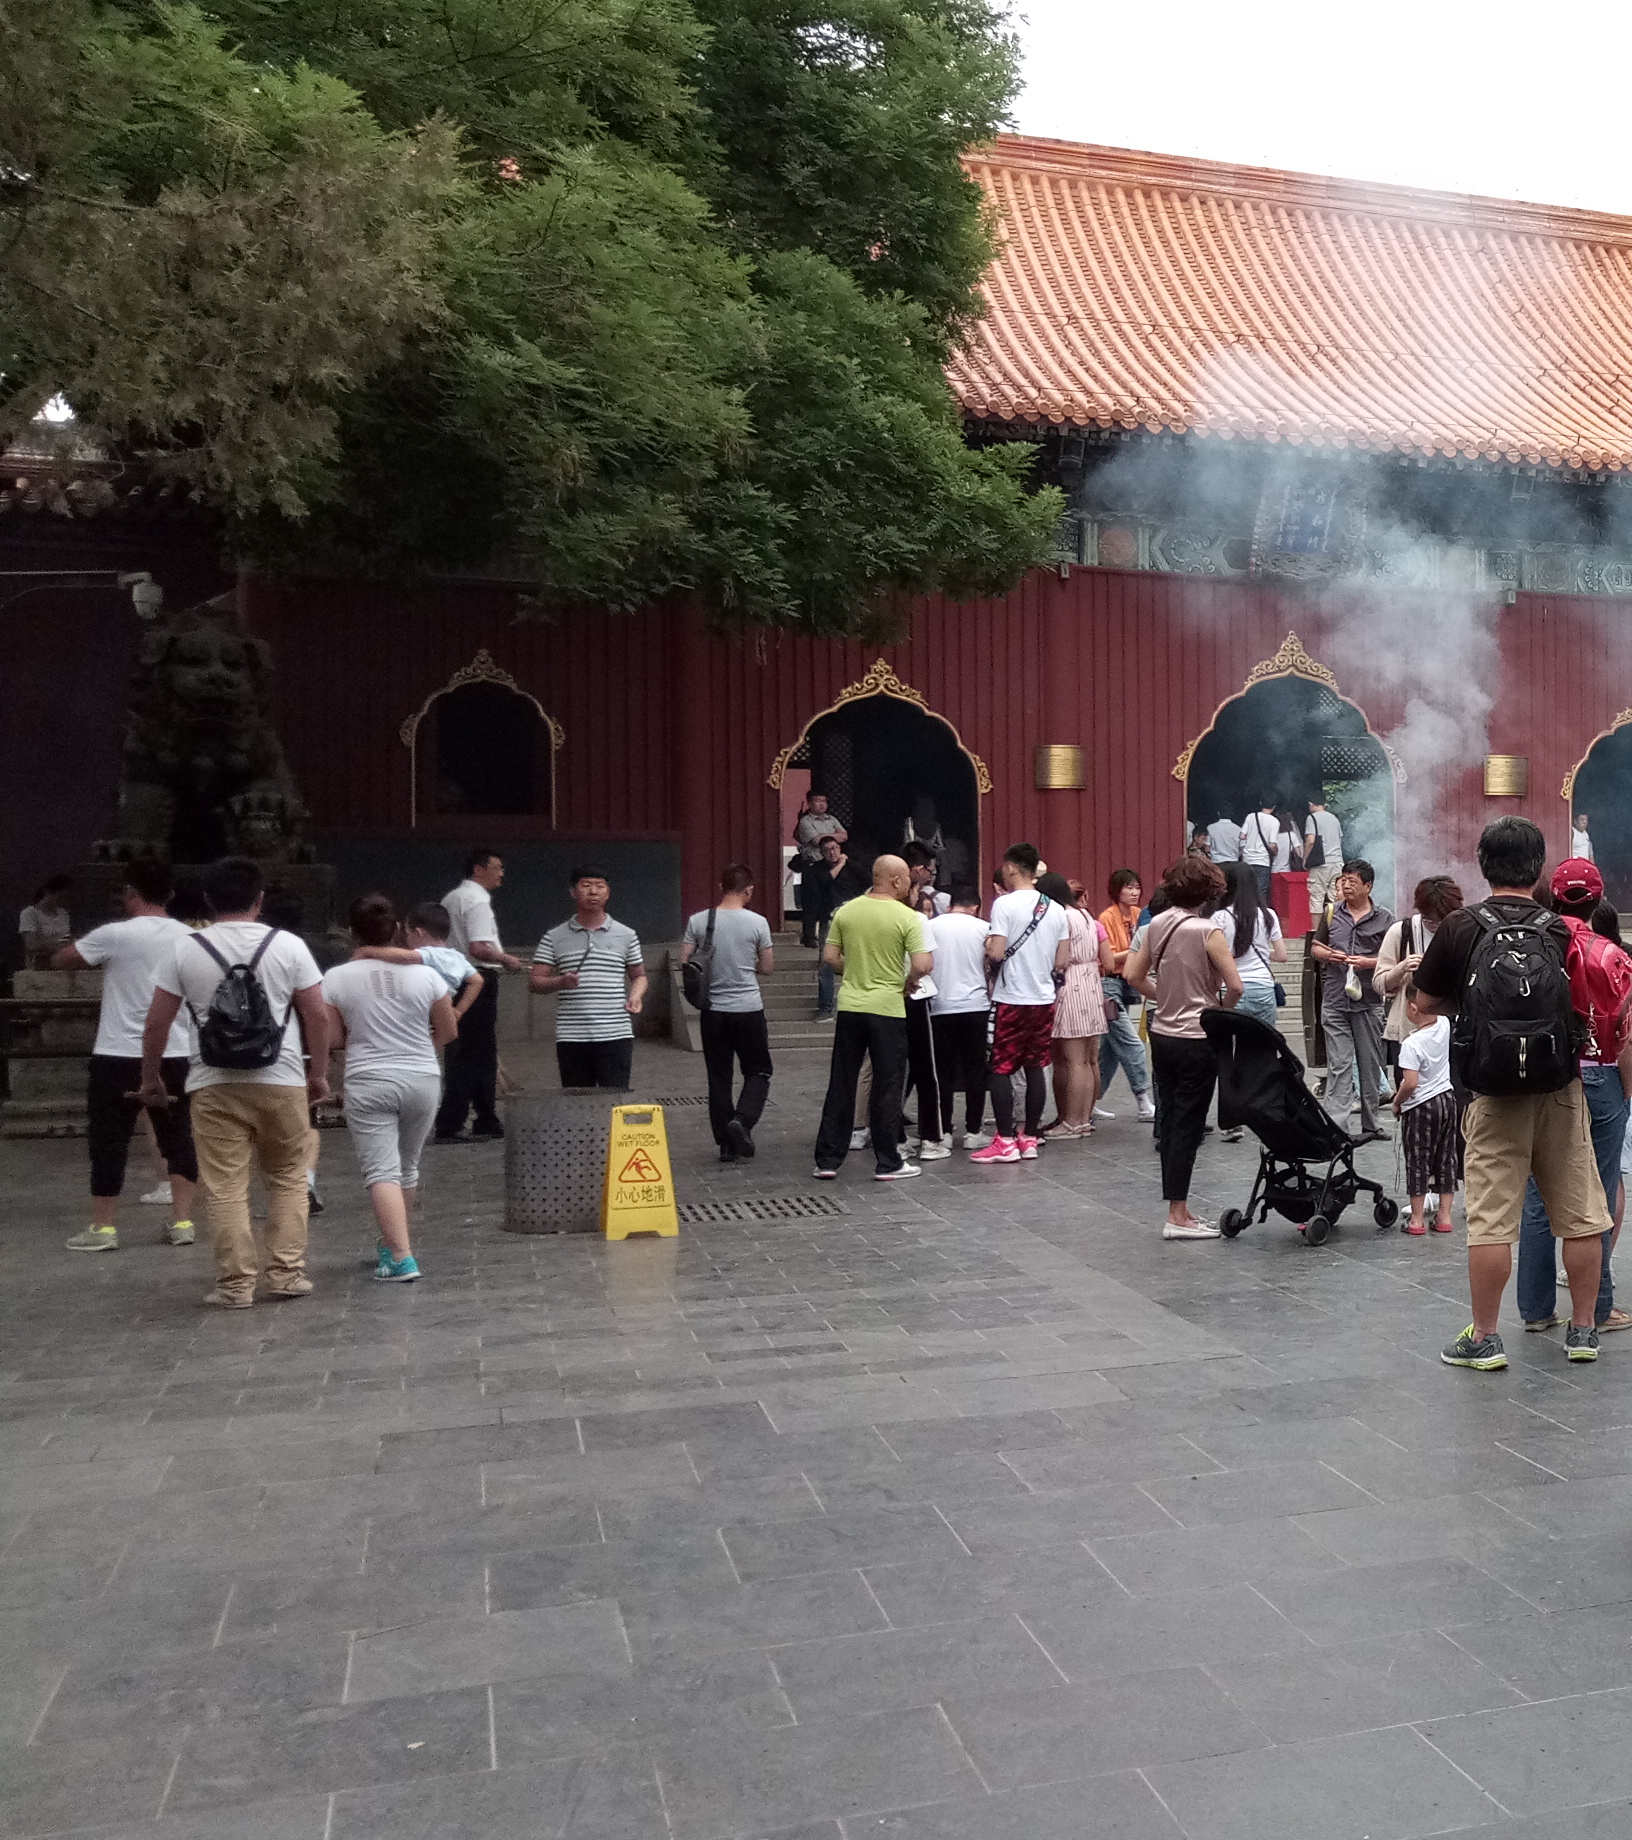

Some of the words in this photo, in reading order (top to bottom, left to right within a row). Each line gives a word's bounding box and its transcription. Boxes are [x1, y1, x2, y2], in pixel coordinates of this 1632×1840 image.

[622, 1133, 656, 1141] CAUTION
[615, 1185, 665, 1203] 小心地滑
